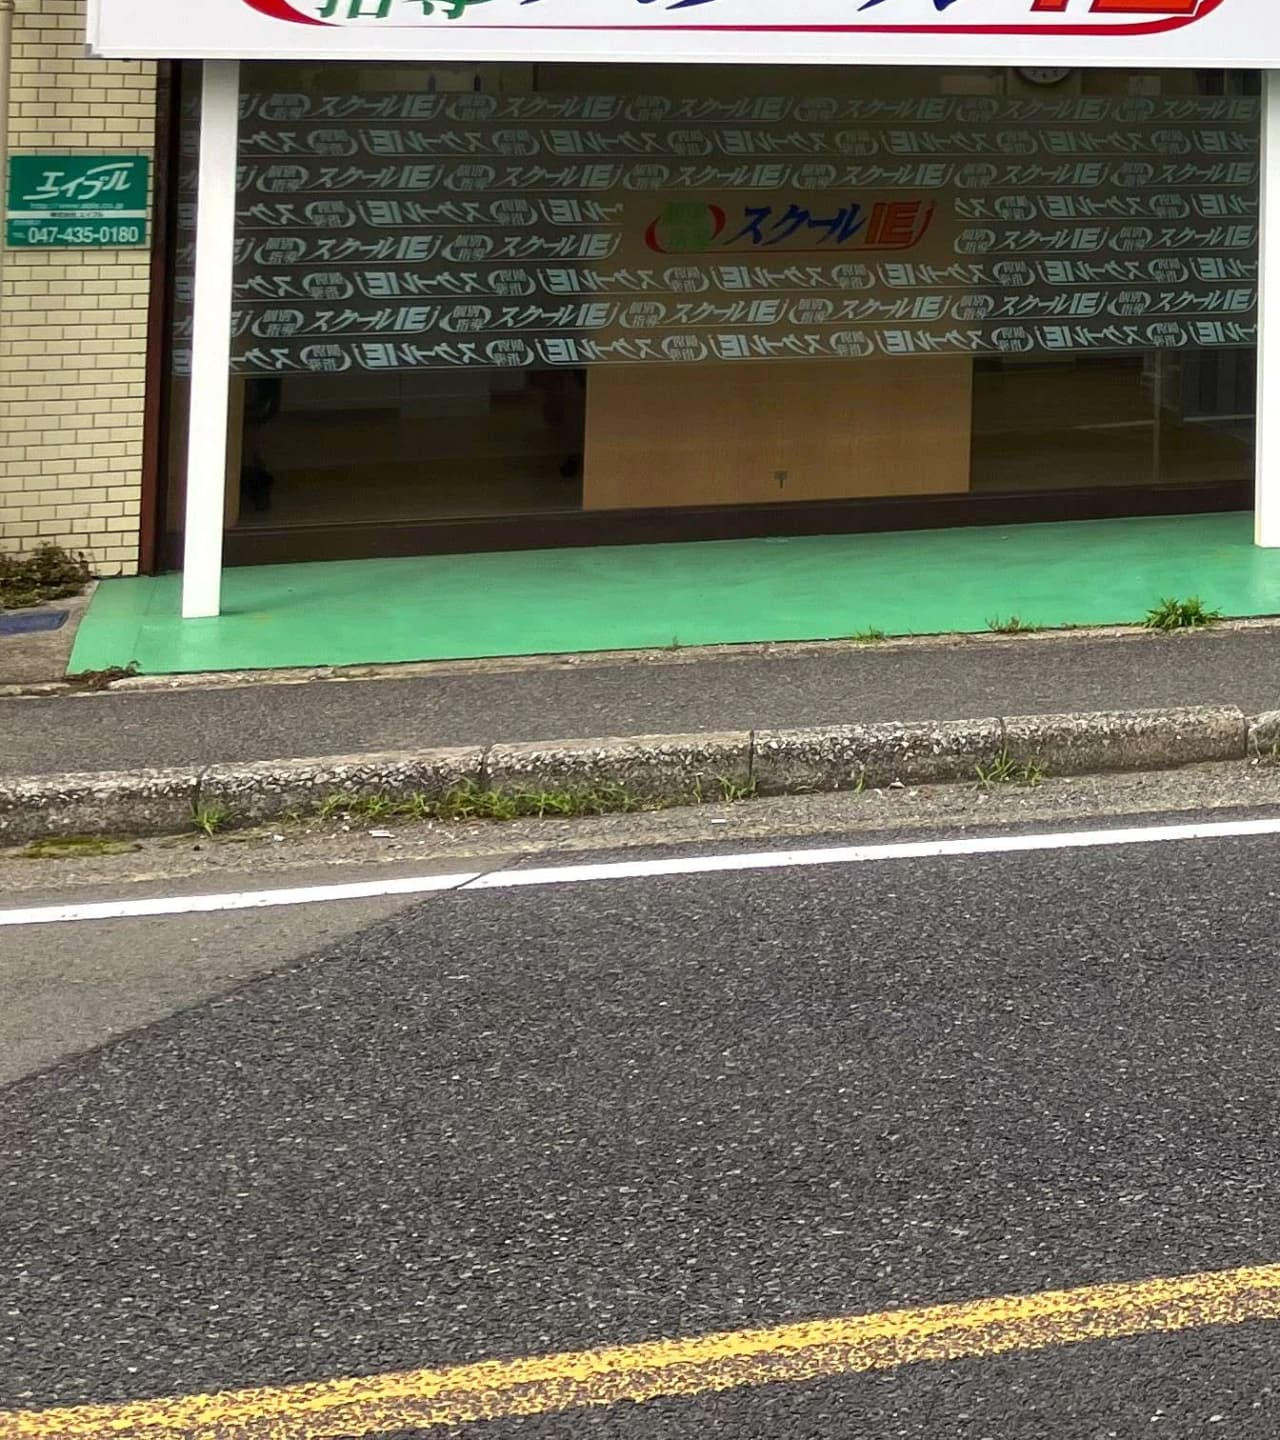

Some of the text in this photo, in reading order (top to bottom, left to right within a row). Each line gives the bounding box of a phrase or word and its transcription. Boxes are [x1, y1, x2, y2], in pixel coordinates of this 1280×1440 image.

[23, 162, 134, 200] エイブル
[28, 226, 139, 243] 047-435-0180
[724, 199, 922, 246] スクールIE
